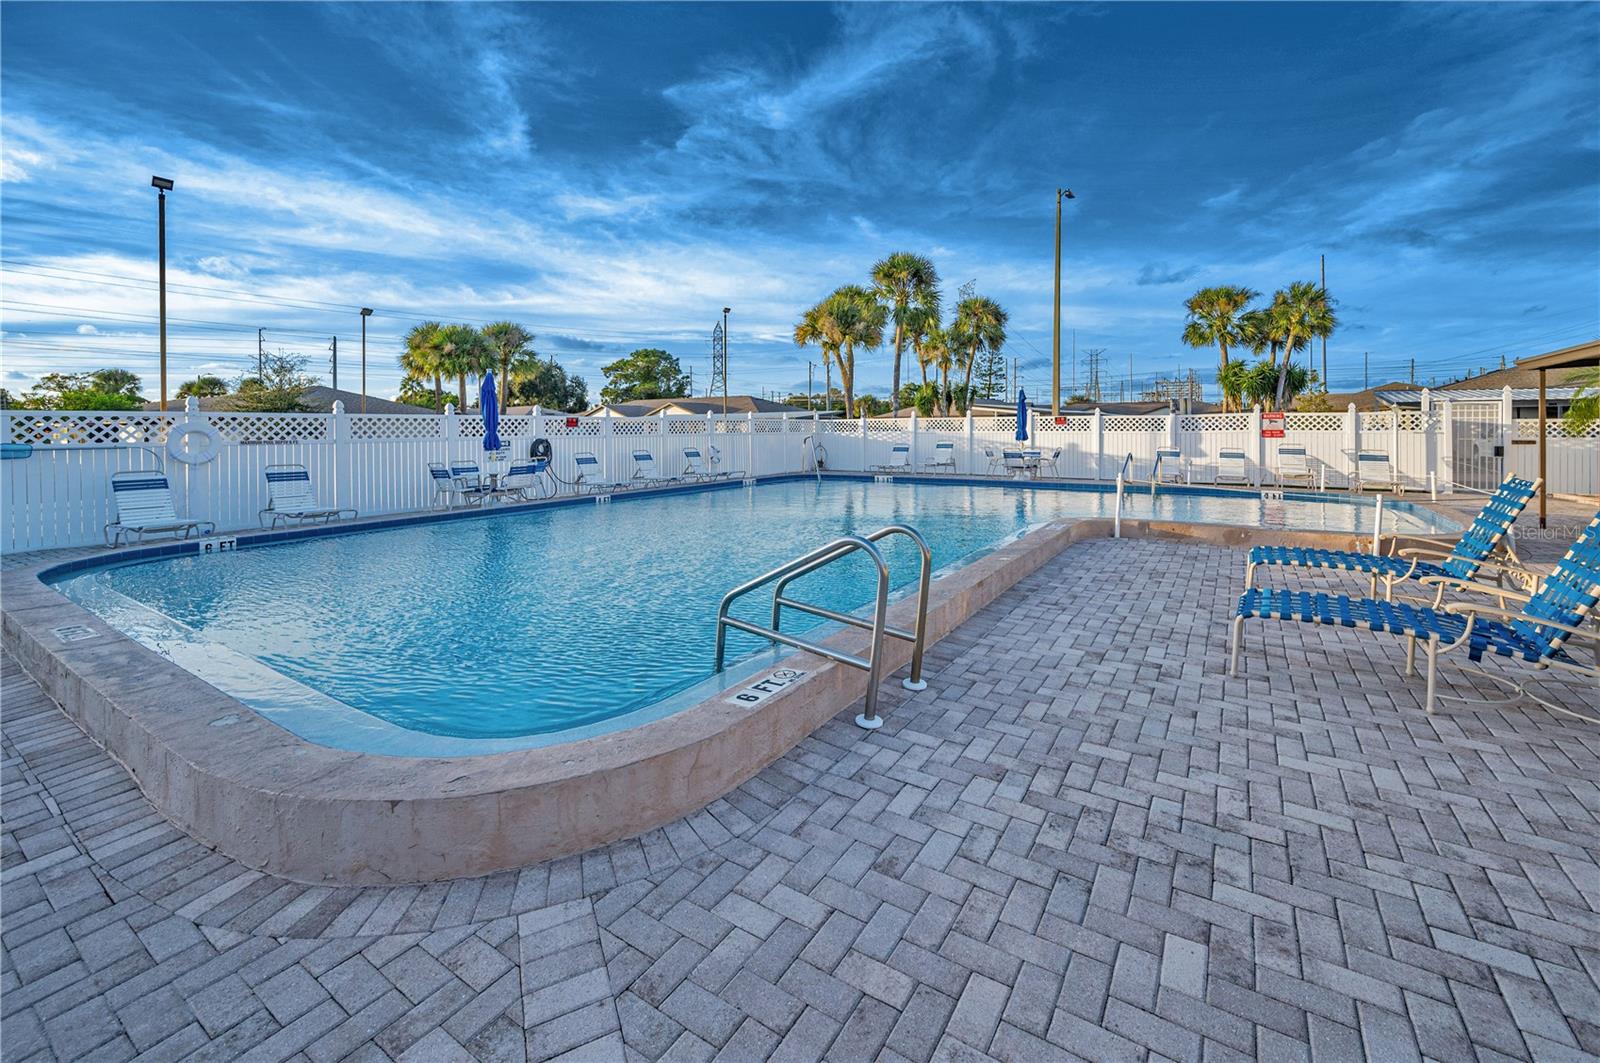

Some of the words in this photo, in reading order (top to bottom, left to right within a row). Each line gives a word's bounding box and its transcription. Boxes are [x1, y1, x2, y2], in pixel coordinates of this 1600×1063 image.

[204, 543, 213, 554] 6
[220, 540, 235, 552] FT
[736, 693, 760, 702] 6
[752, 679, 786, 693] FT
